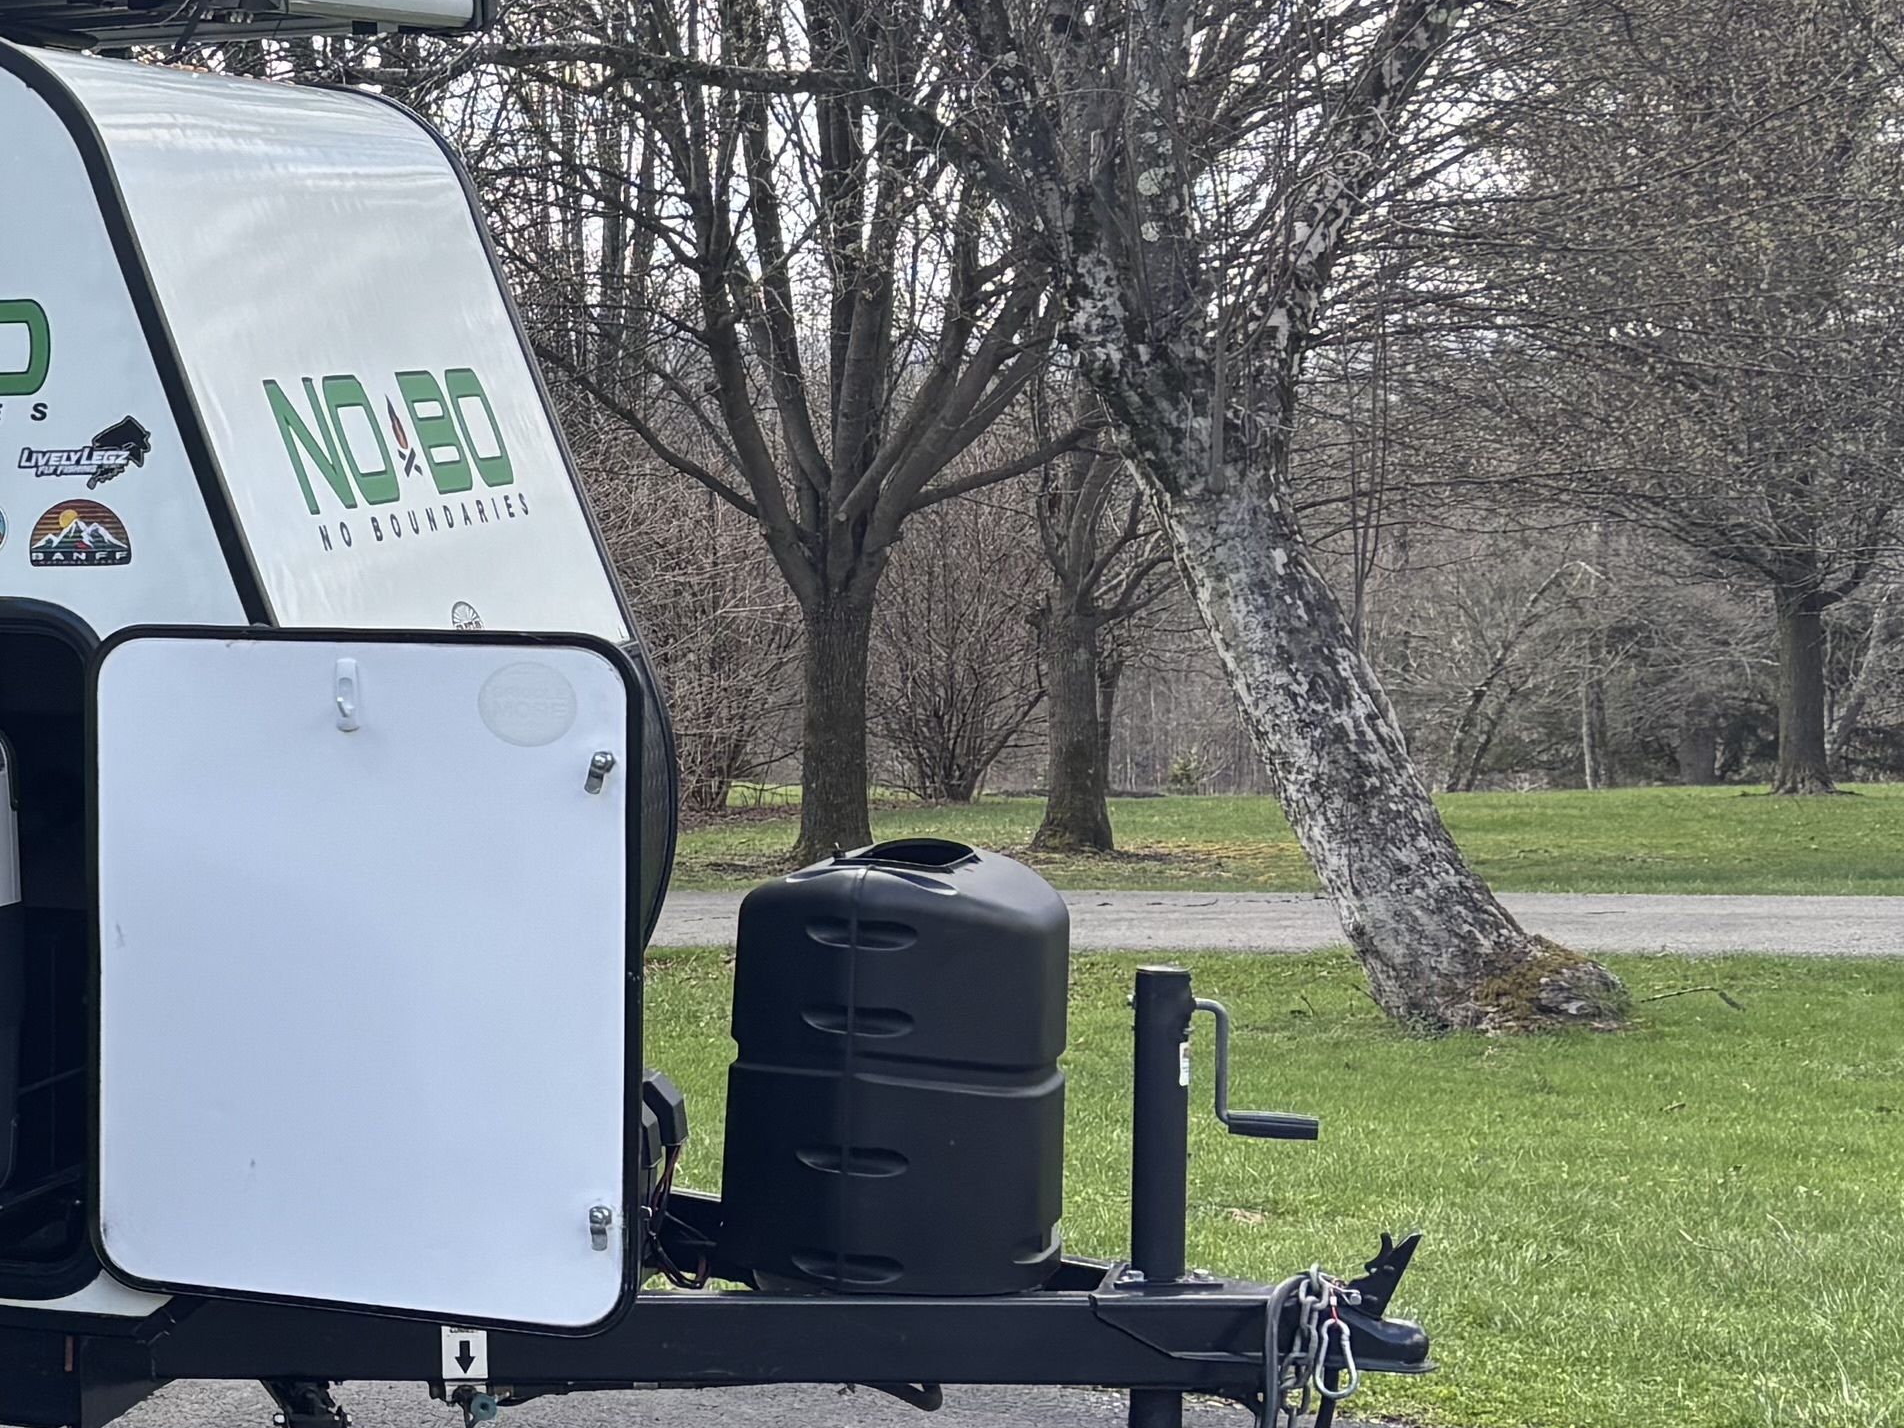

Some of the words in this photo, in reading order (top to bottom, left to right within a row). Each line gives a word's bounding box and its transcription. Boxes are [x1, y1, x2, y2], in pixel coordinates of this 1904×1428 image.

[320, 521, 353, 551] NO
[370, 492, 530, 543] BOUNDARIES
[32, 552, 128, 560] BANFF
